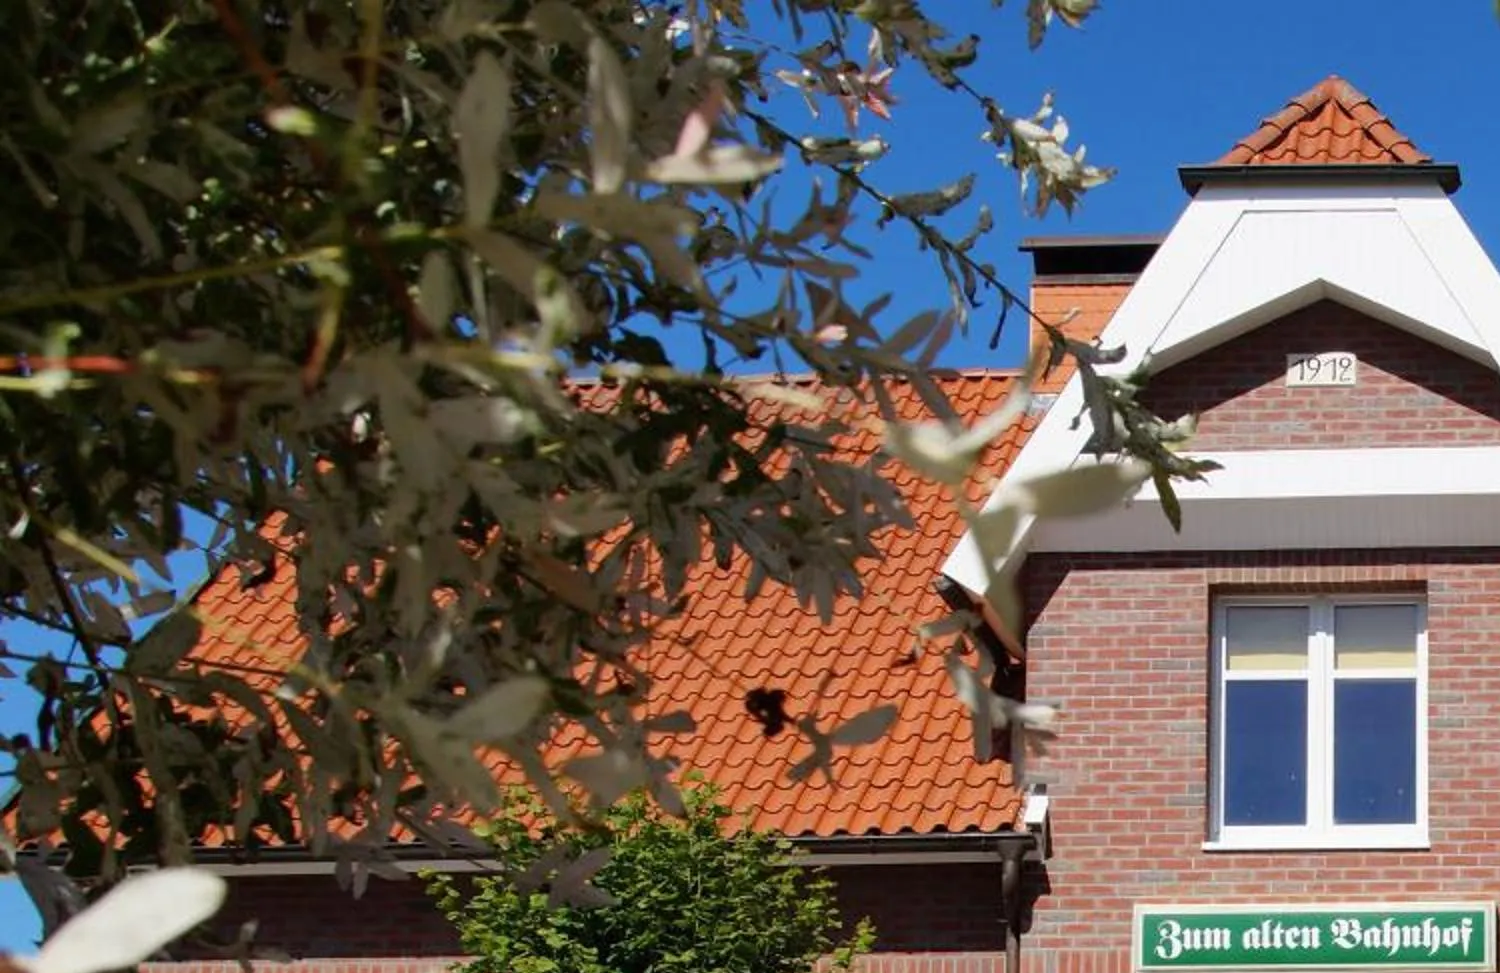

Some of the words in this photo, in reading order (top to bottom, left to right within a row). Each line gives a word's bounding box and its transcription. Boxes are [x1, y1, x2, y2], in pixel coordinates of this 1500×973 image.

[1154, 919, 1232, 960] Zum
[1242, 919, 1321, 950] alten
[1331, 916, 1474, 957] Bahnhof
